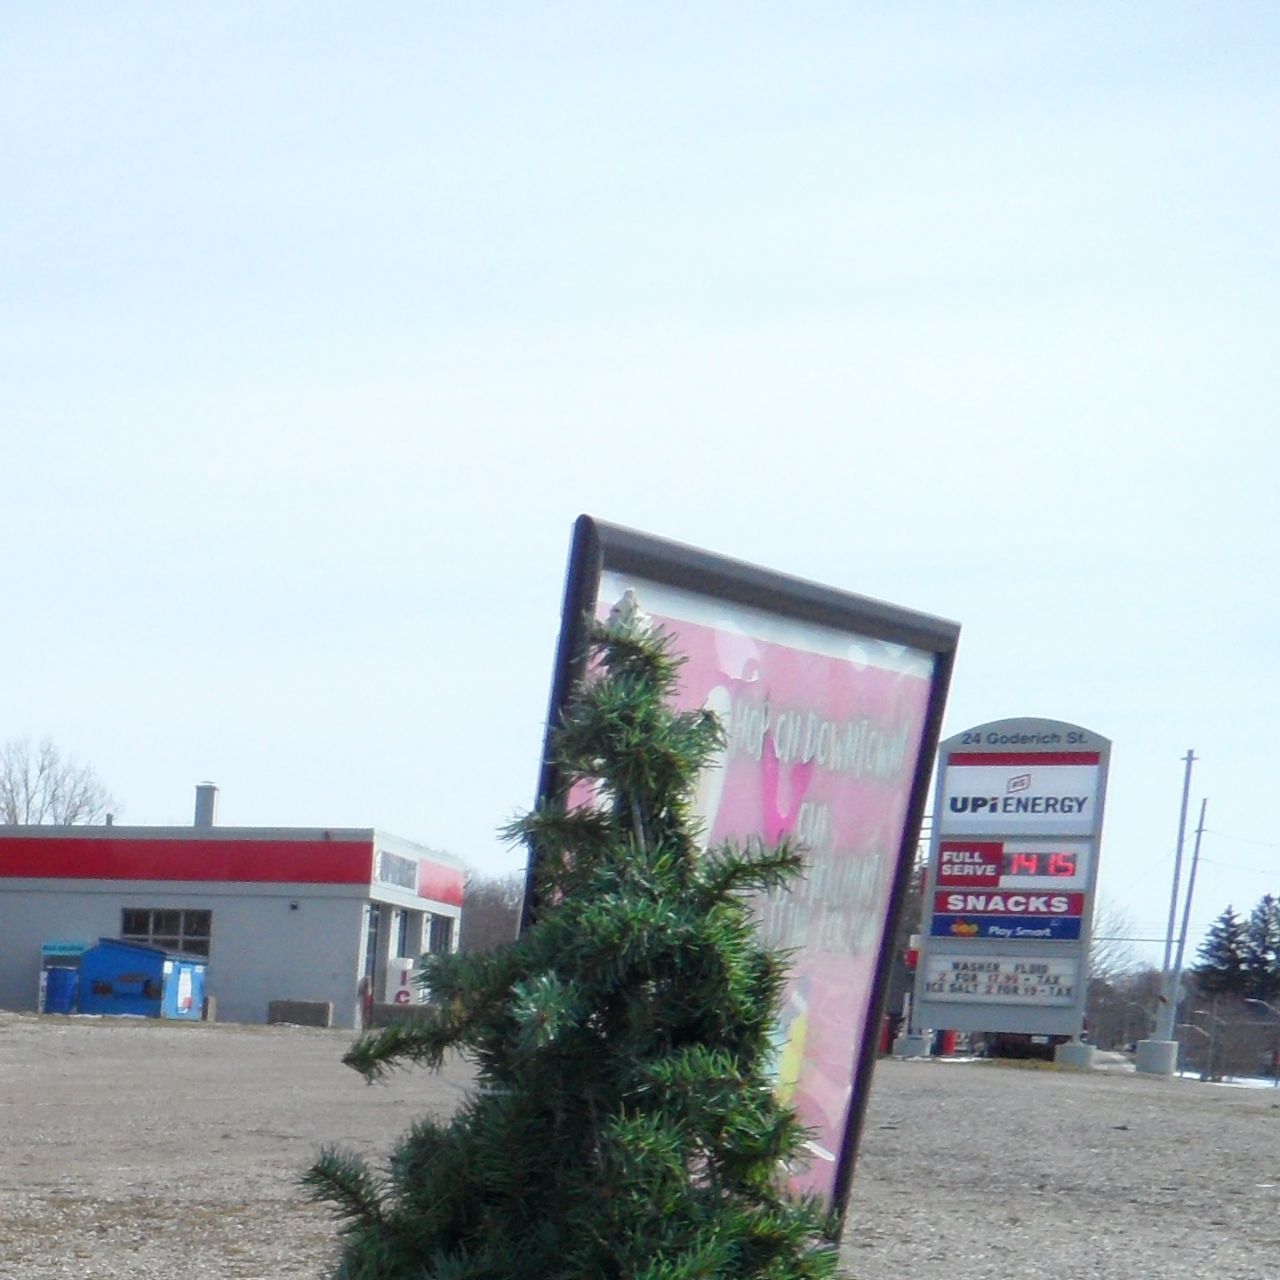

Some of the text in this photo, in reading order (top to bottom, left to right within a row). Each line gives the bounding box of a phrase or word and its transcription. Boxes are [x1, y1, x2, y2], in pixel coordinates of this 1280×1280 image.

[962, 731, 1088, 745] 24 Goderich St.
[1001, 796, 1088, 813] ENERGY
[942, 851, 983, 863] FULL
[942, 864, 997, 876] SERVE
[946, 895, 1069, 913] SNACKS
[988, 925, 1012, 938] Play
[1015, 926, 1052, 937] Smart
[952, 961, 1000, 973] WASHER
[938, 972, 947, 982] 2
[955, 972, 978, 983] FOR
[1037, 975, 1060, 985] TAX
[926, 982, 944, 993] ICE
[949, 983, 978, 994] SALT
[984, 984, 994, 995] 2
[997, 985, 1019, 996] FOR
[1050, 986, 1073, 997] TAX
